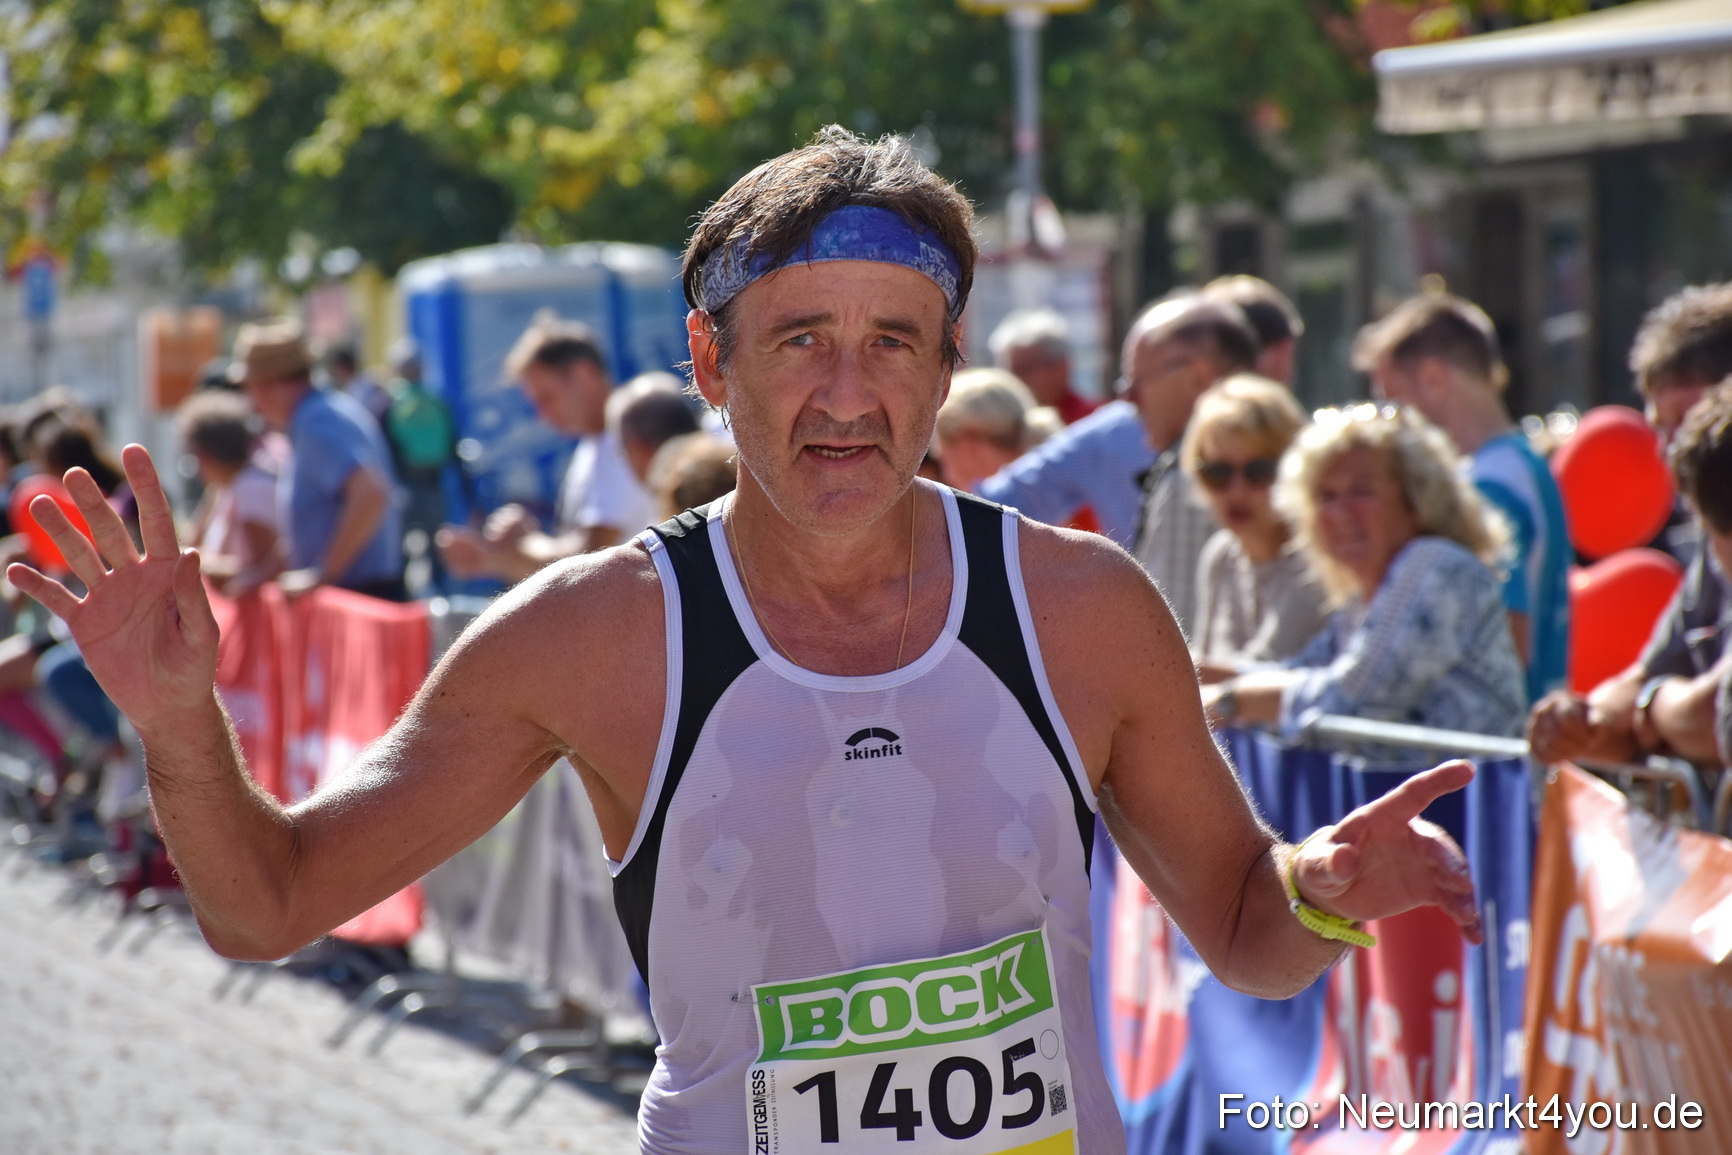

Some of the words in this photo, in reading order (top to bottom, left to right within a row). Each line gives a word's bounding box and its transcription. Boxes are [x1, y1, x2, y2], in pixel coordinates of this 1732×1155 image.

[844, 743, 903, 761] skinfit
[780, 944, 1034, 1051] BOCK
[792, 1037, 1046, 1143] 1405
[771, 1106, 779, 1155] TRANSPONDER
